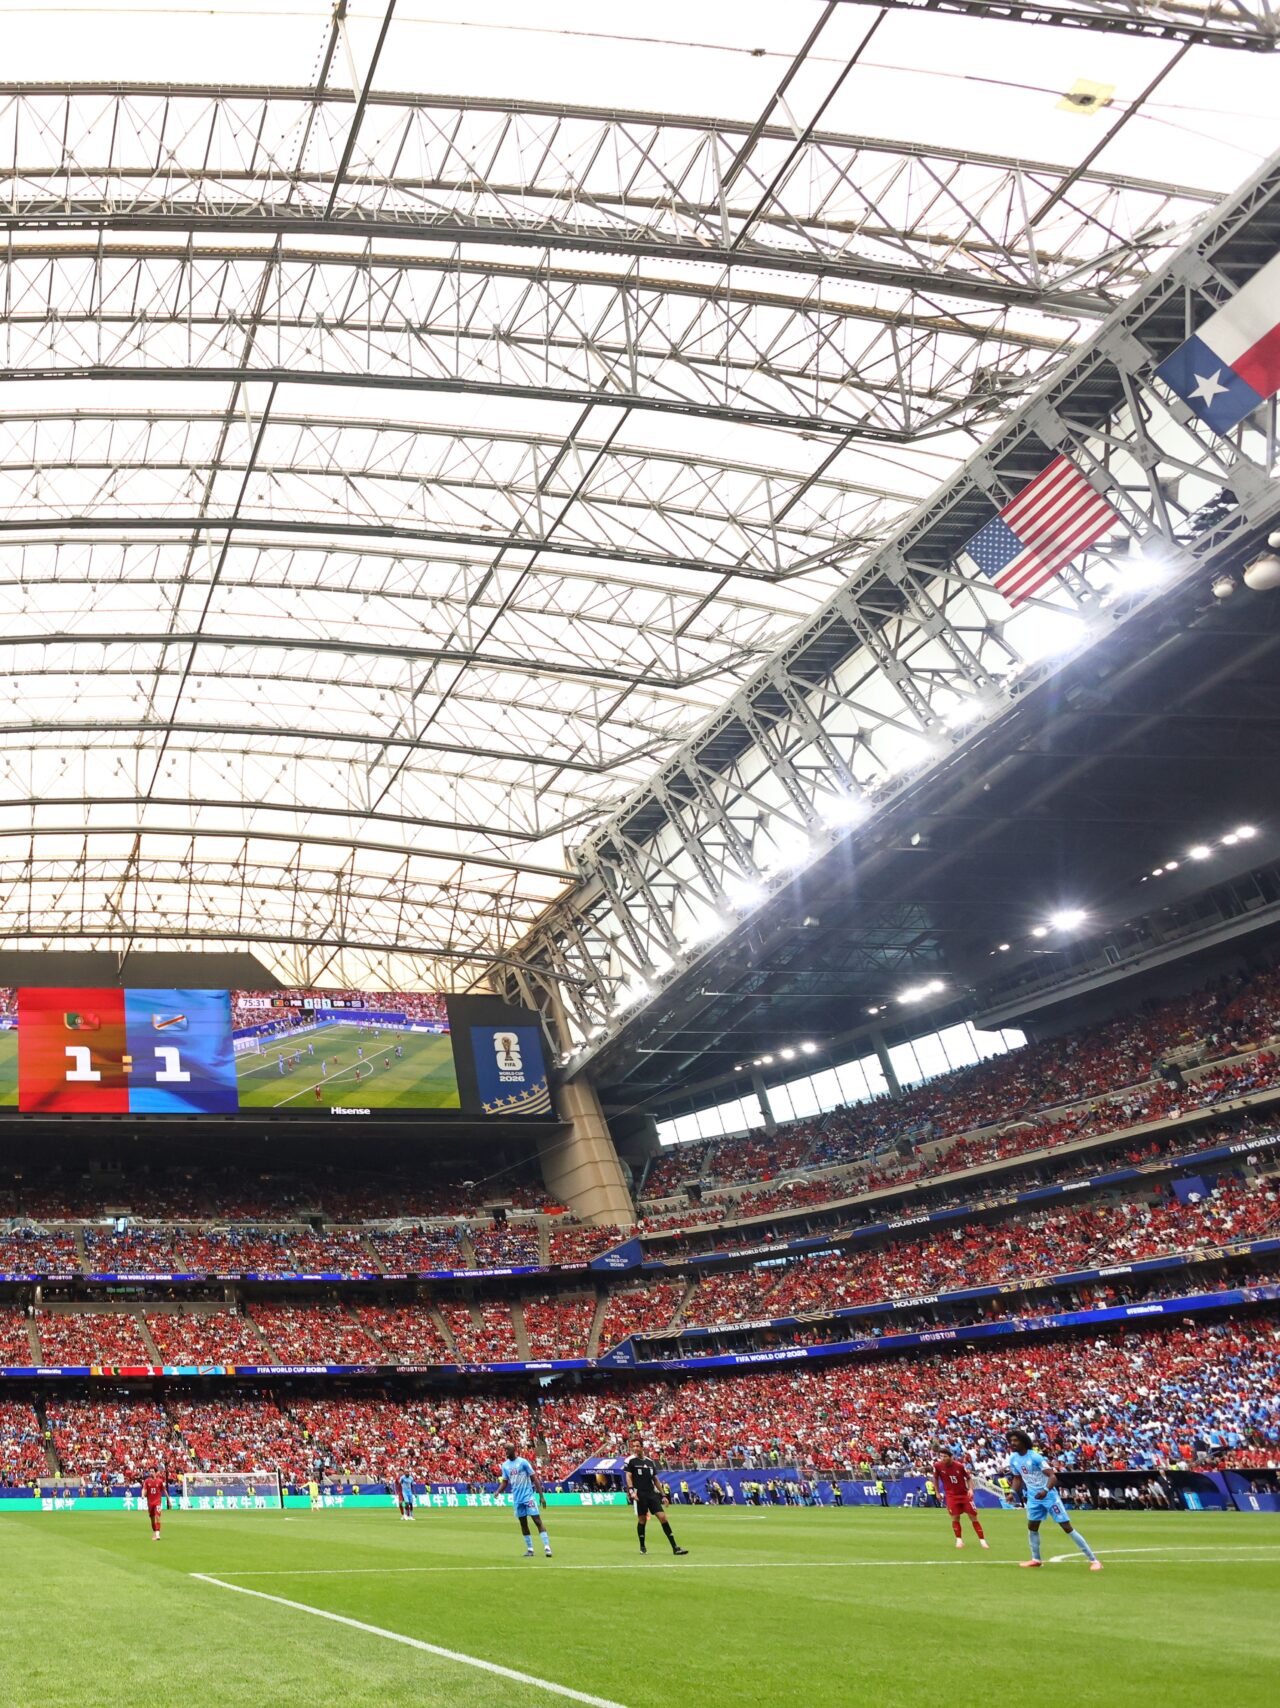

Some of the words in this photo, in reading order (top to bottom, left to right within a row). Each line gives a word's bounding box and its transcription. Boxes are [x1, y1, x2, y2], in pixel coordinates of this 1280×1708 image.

[243, 999, 265, 1007] 75:31
[65, 1046, 101, 1081] 1
[154, 1046, 191, 1082] 1
[331, 1106, 372, 1116] Hisense
[1229, 1143, 1247, 1154] FIFA
[1246, 1137, 1276, 1150] WORLD
[888, 1216, 931, 1230] HOUSTON
[740, 1248, 758, 1257] WORLD
[769, 1243, 788, 1253] 2026
[893, 1296, 938, 1309] HOUSTON
[719, 1324, 740, 1333] WORLD
[751, 1321, 771, 1329] 2026
[919, 1331, 956, 1343] HOUSTON
[735, 1355, 751, 1363] FIFA
[751, 1353, 774, 1362] WORLD
[774, 1352, 787, 1360] CUP
[786, 1350, 808, 1358] 2026
[147, 1366, 155, 1376] 1
[171, 1366, 180, 1375] 1
[949, 1475, 958, 1484] 15
